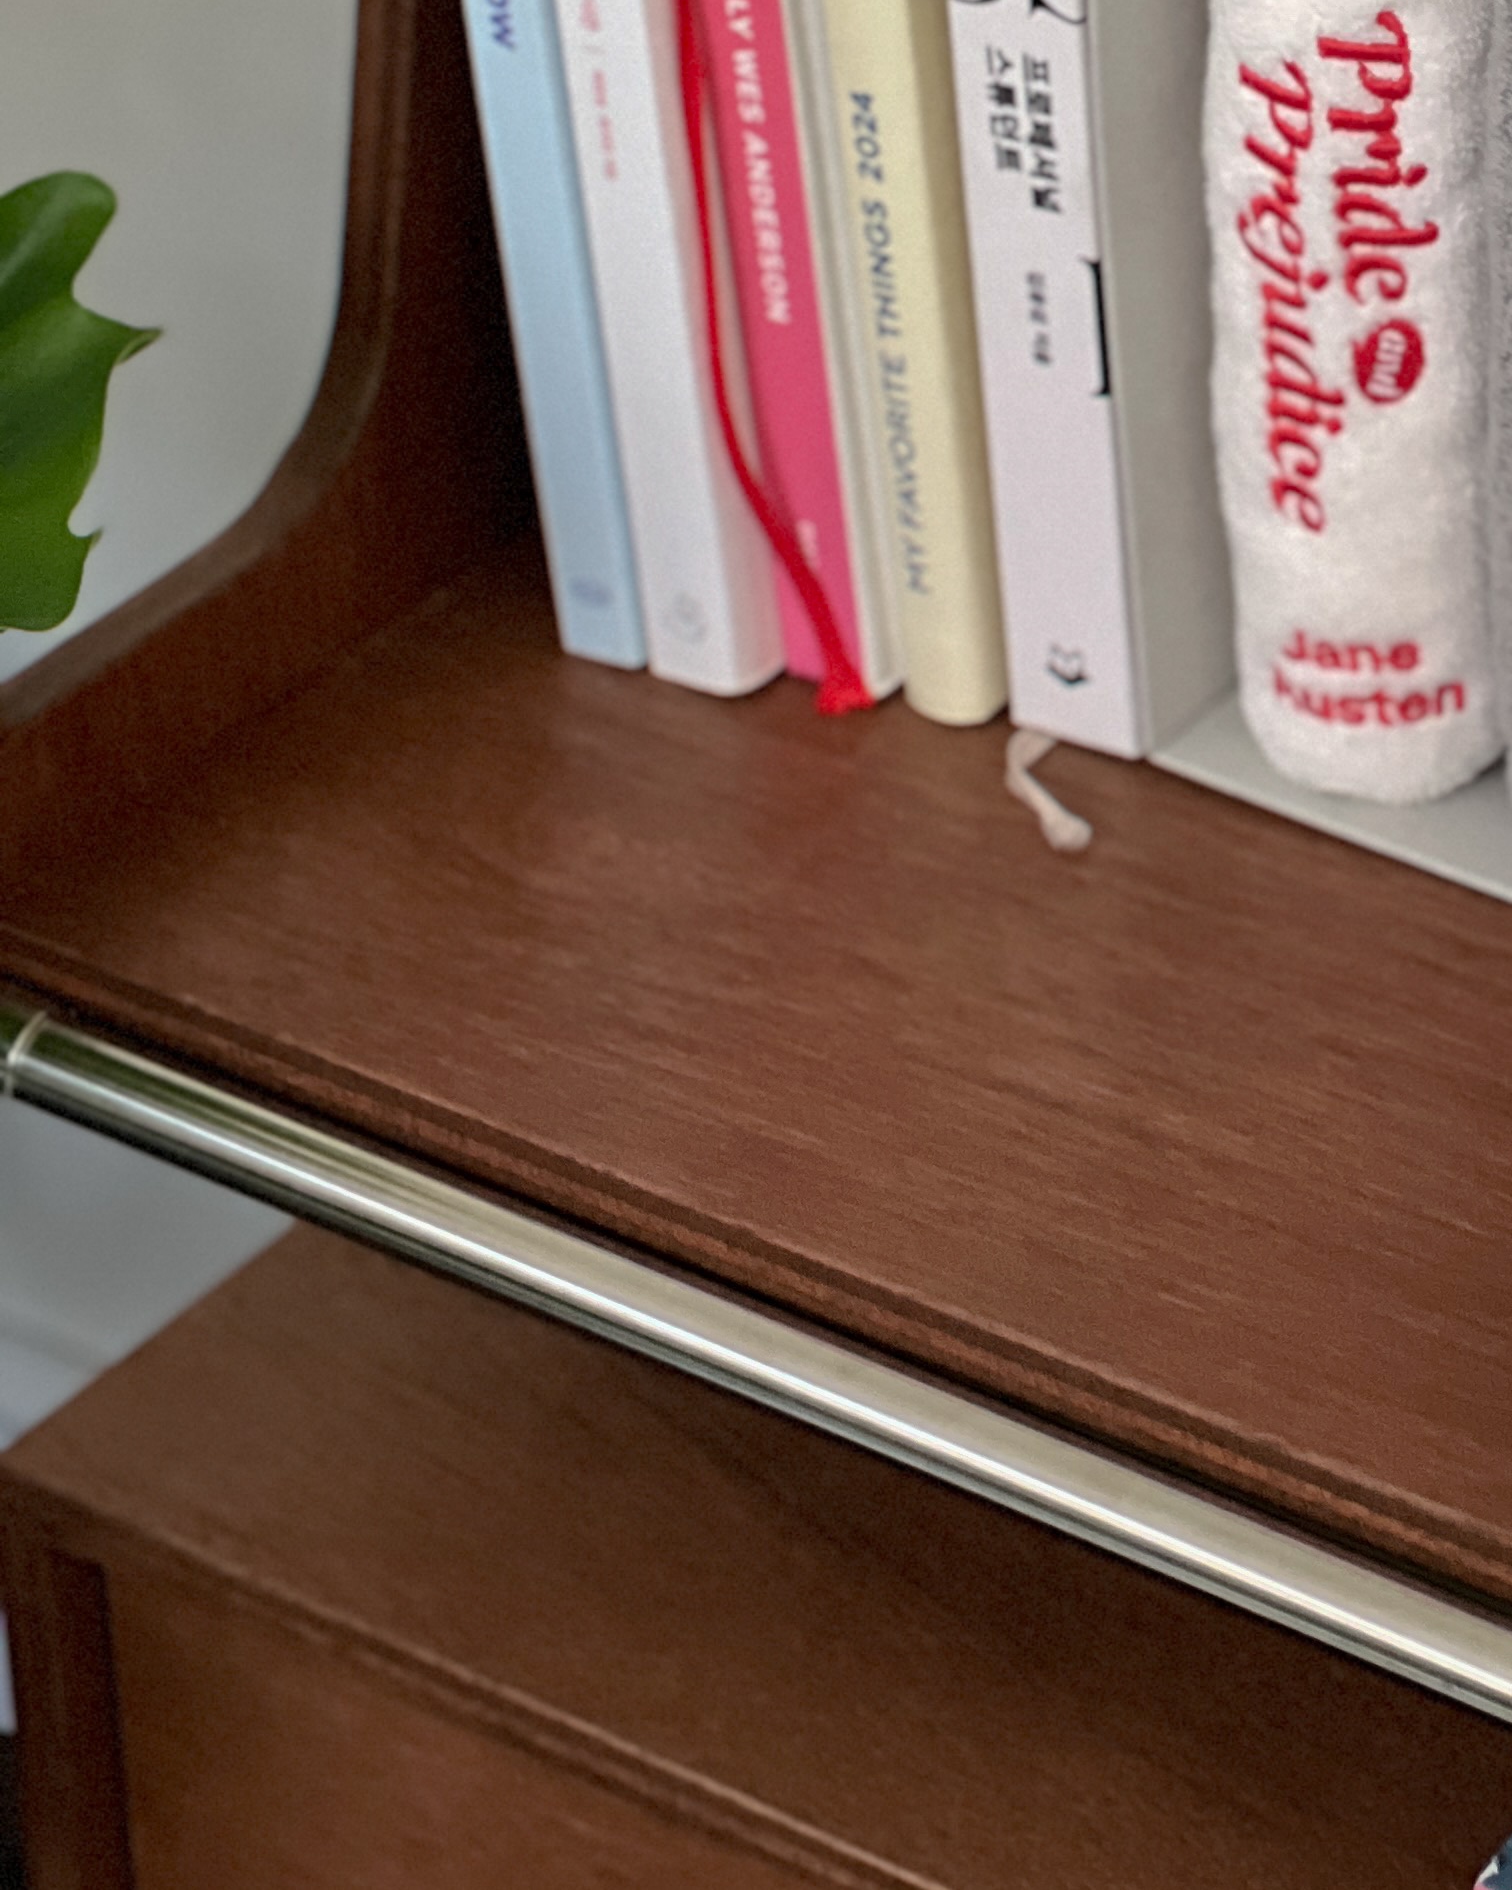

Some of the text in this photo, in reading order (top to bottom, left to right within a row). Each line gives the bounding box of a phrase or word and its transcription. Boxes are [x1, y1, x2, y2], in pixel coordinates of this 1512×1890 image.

[732, 47, 766, 124] WES
[847, 90, 884, 185] 2024
[1317, 10, 1440, 307] Pride
[742, 129, 793, 327] ANDERSON
[861, 200, 904, 345] THINGS
[1236, 57, 1346, 534] Prejudice
[879, 353, 921, 531] FAVORITE
